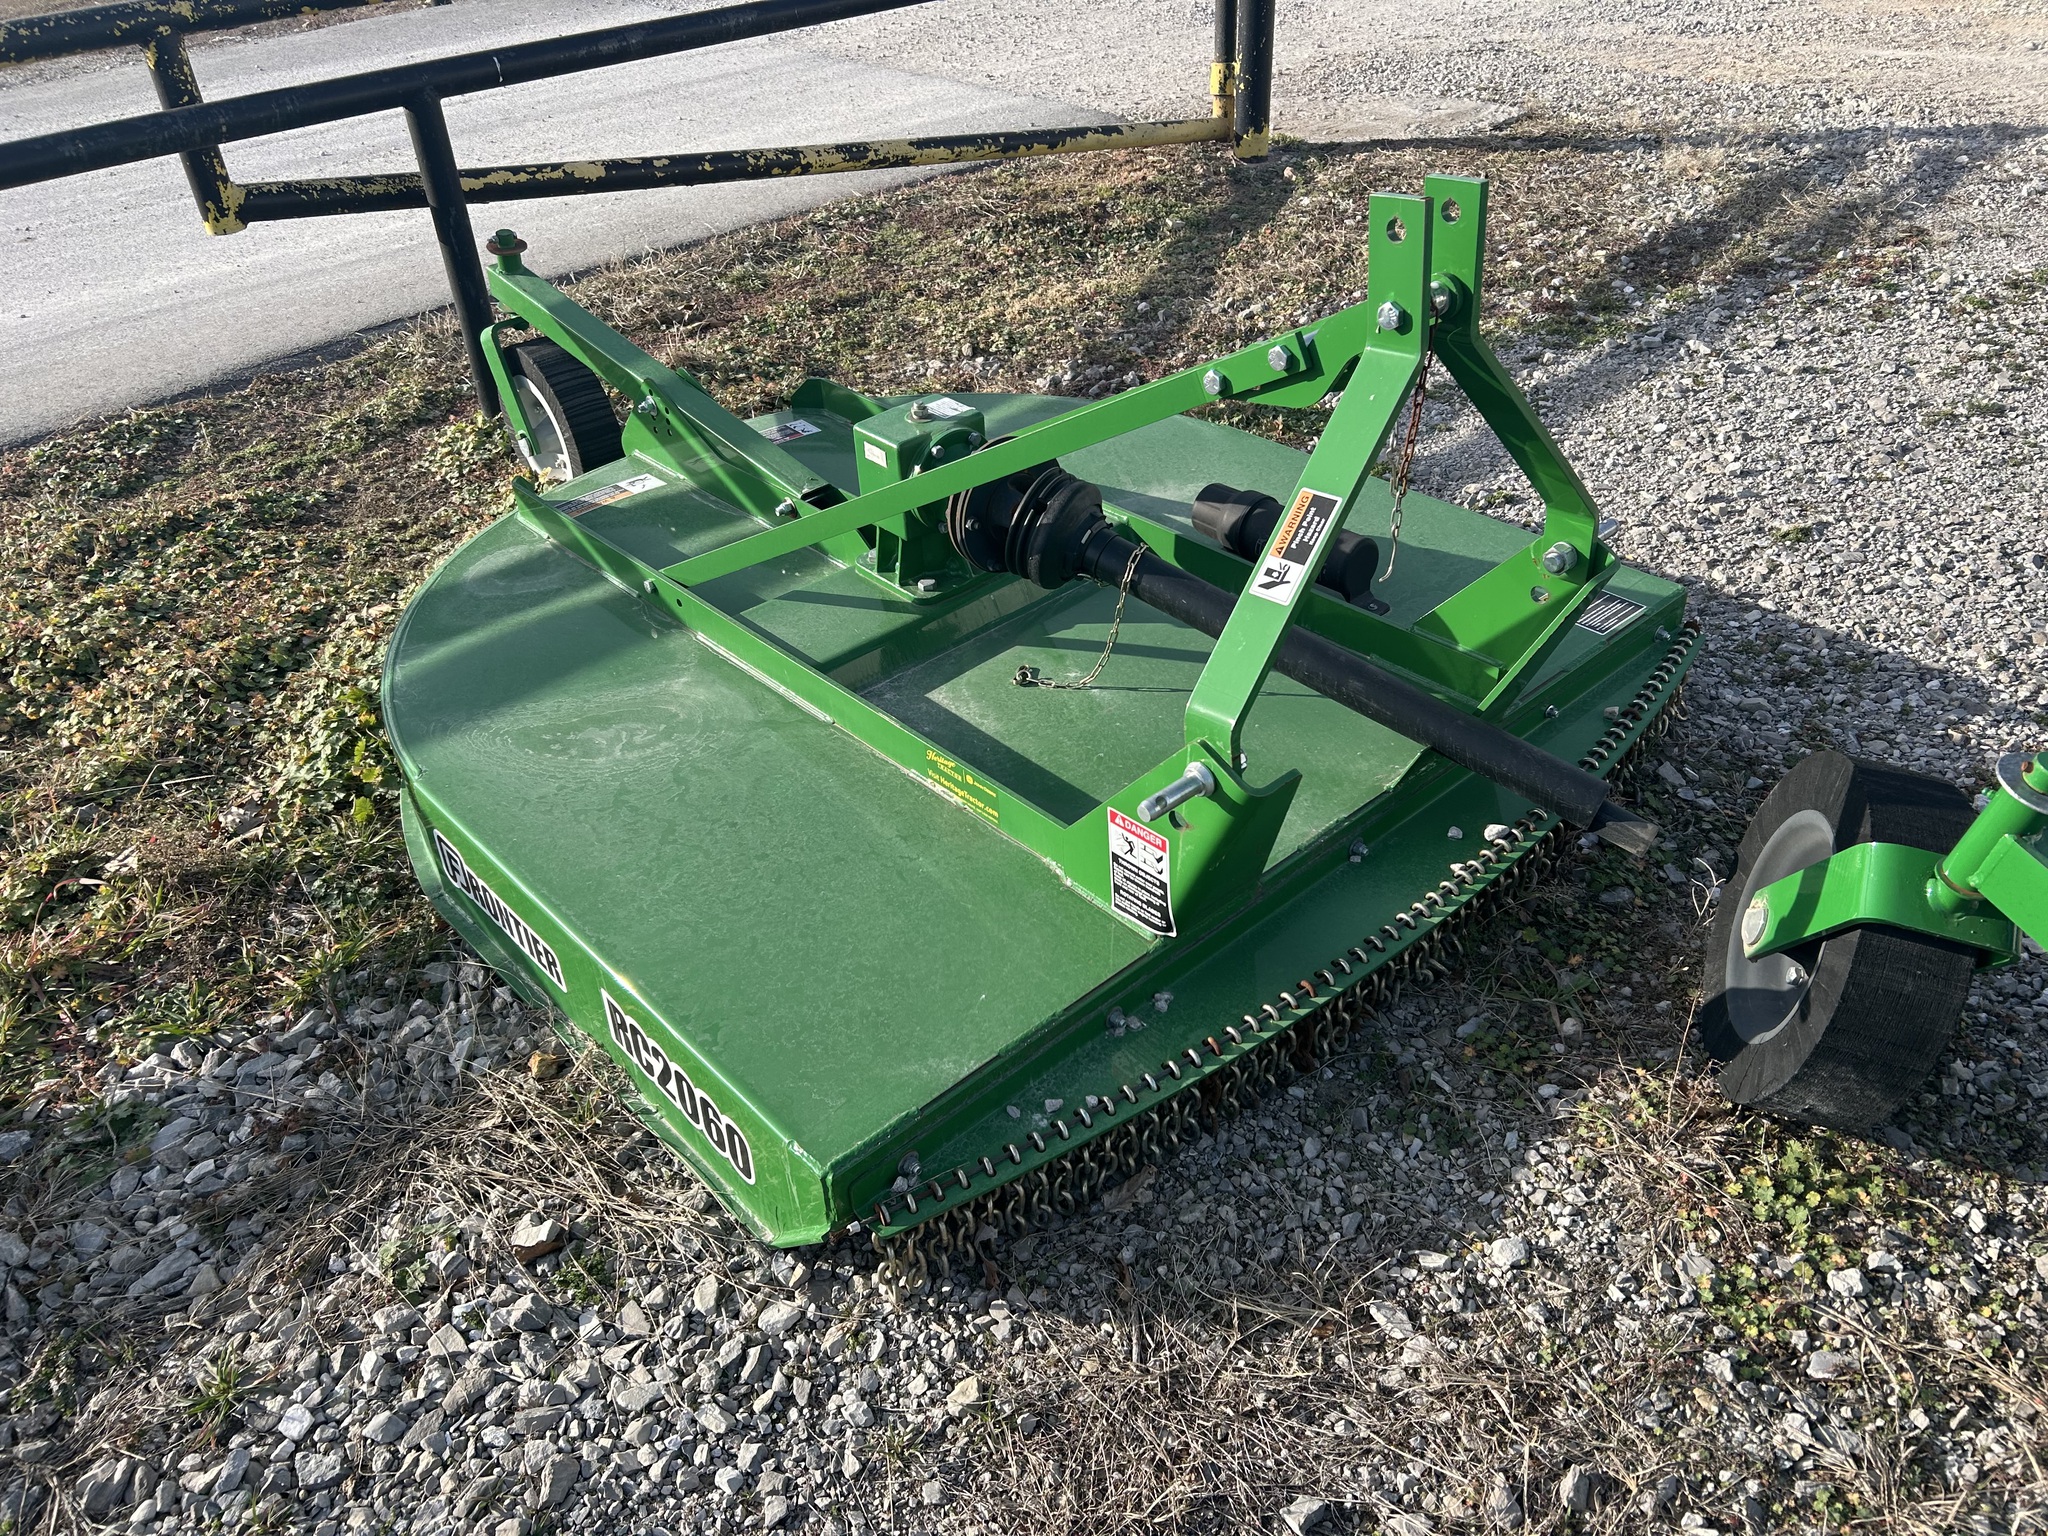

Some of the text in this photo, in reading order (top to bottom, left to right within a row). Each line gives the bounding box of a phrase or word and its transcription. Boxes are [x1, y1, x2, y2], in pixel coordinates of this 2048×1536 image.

[1279, 496, 1309, 547] WARNING
[1290, 506, 1317, 549] Pinch Point
[1302, 515, 1320, 543] Hazard
[926, 749, 956, 769] Heritage
[940, 775, 999, 819] HeritageTractor.com
[1124, 819, 1163, 849] DANGER
[436, 834, 563, 987] FRONTIER
[607, 997, 752, 1180] RC2060
